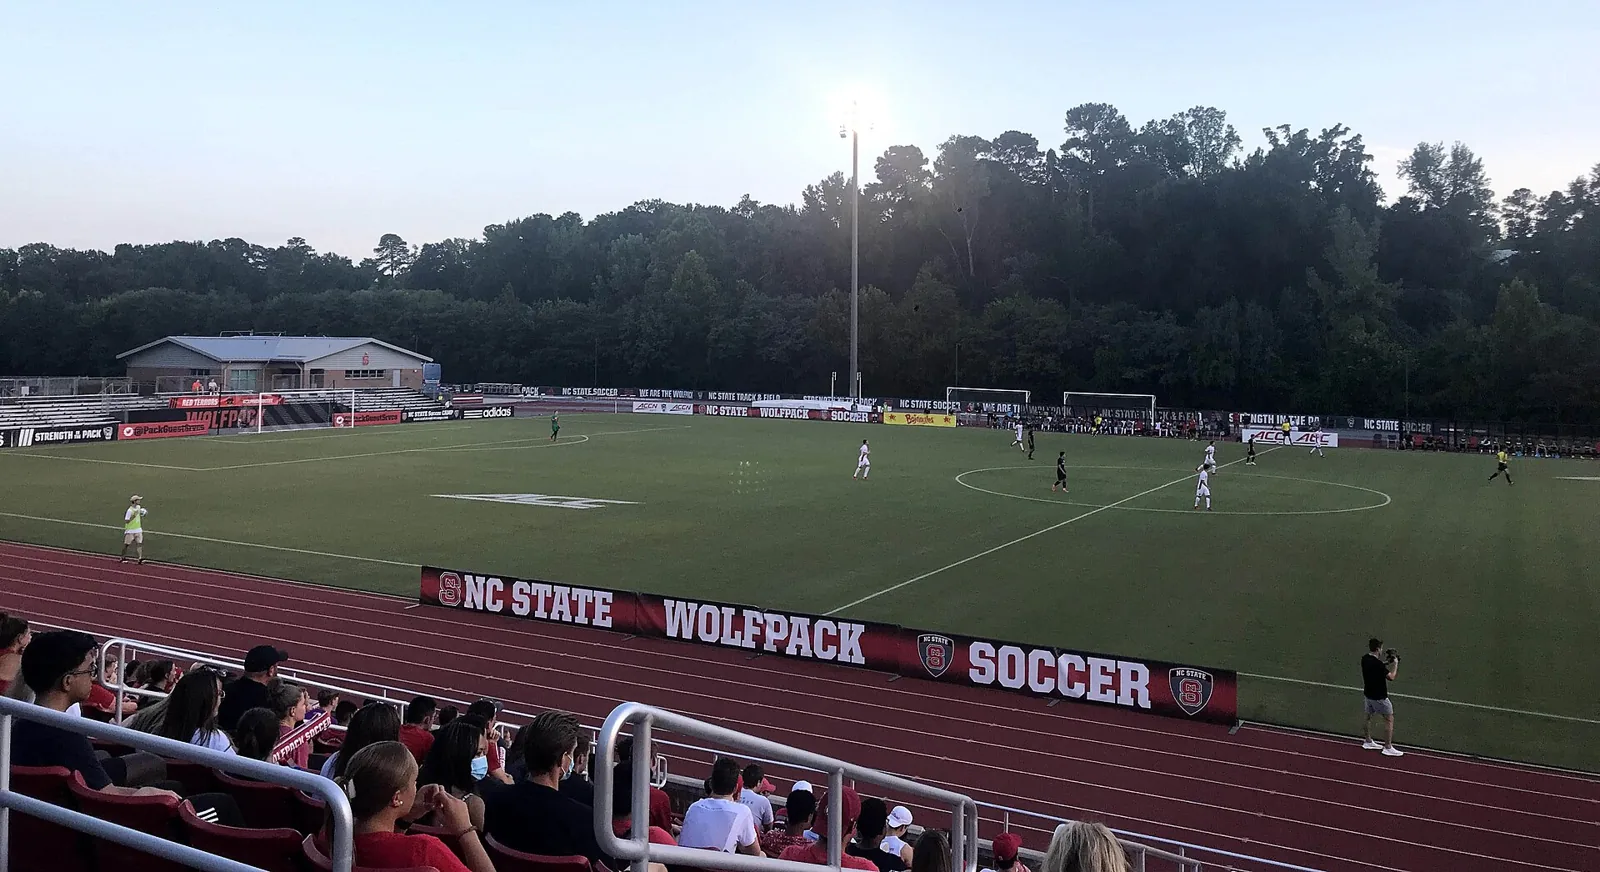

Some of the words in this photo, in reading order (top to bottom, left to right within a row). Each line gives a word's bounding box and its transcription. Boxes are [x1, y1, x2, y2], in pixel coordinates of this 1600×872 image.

[562, 388, 572, 396] NC
[639, 389, 649, 397] WE
[650, 390, 660, 398] ARE
[661, 390, 672, 398] THE
[708, 392, 717, 400] NC
[718, 392, 736, 401] STATE
[737, 394, 756, 402] TRACK
[900, 400, 910, 408] NC
[911, 400, 932, 409] STATE
[996, 403, 1012, 412] ARE
[483, 407, 511, 418] adidas
[706, 406, 718, 415] NC
[720, 407, 748, 417] STATE
[760, 408, 809, 419] WOLFPACK
[1364, 419, 1375, 429] NC
[1376, 420, 1399, 430] STATE
[35, 431, 73, 441] STRENGTH
[82, 429, 102, 439] PACK
[464, 574, 504, 613] NC
[512, 581, 613, 628] STATE
[664, 599, 865, 665] WOLFPACK
[969, 642, 1151, 709] SOCCER
[931, 637, 948, 646] STATE
[1186, 670, 1207, 681] STATE
[305, 716, 331, 741] SOCCER
